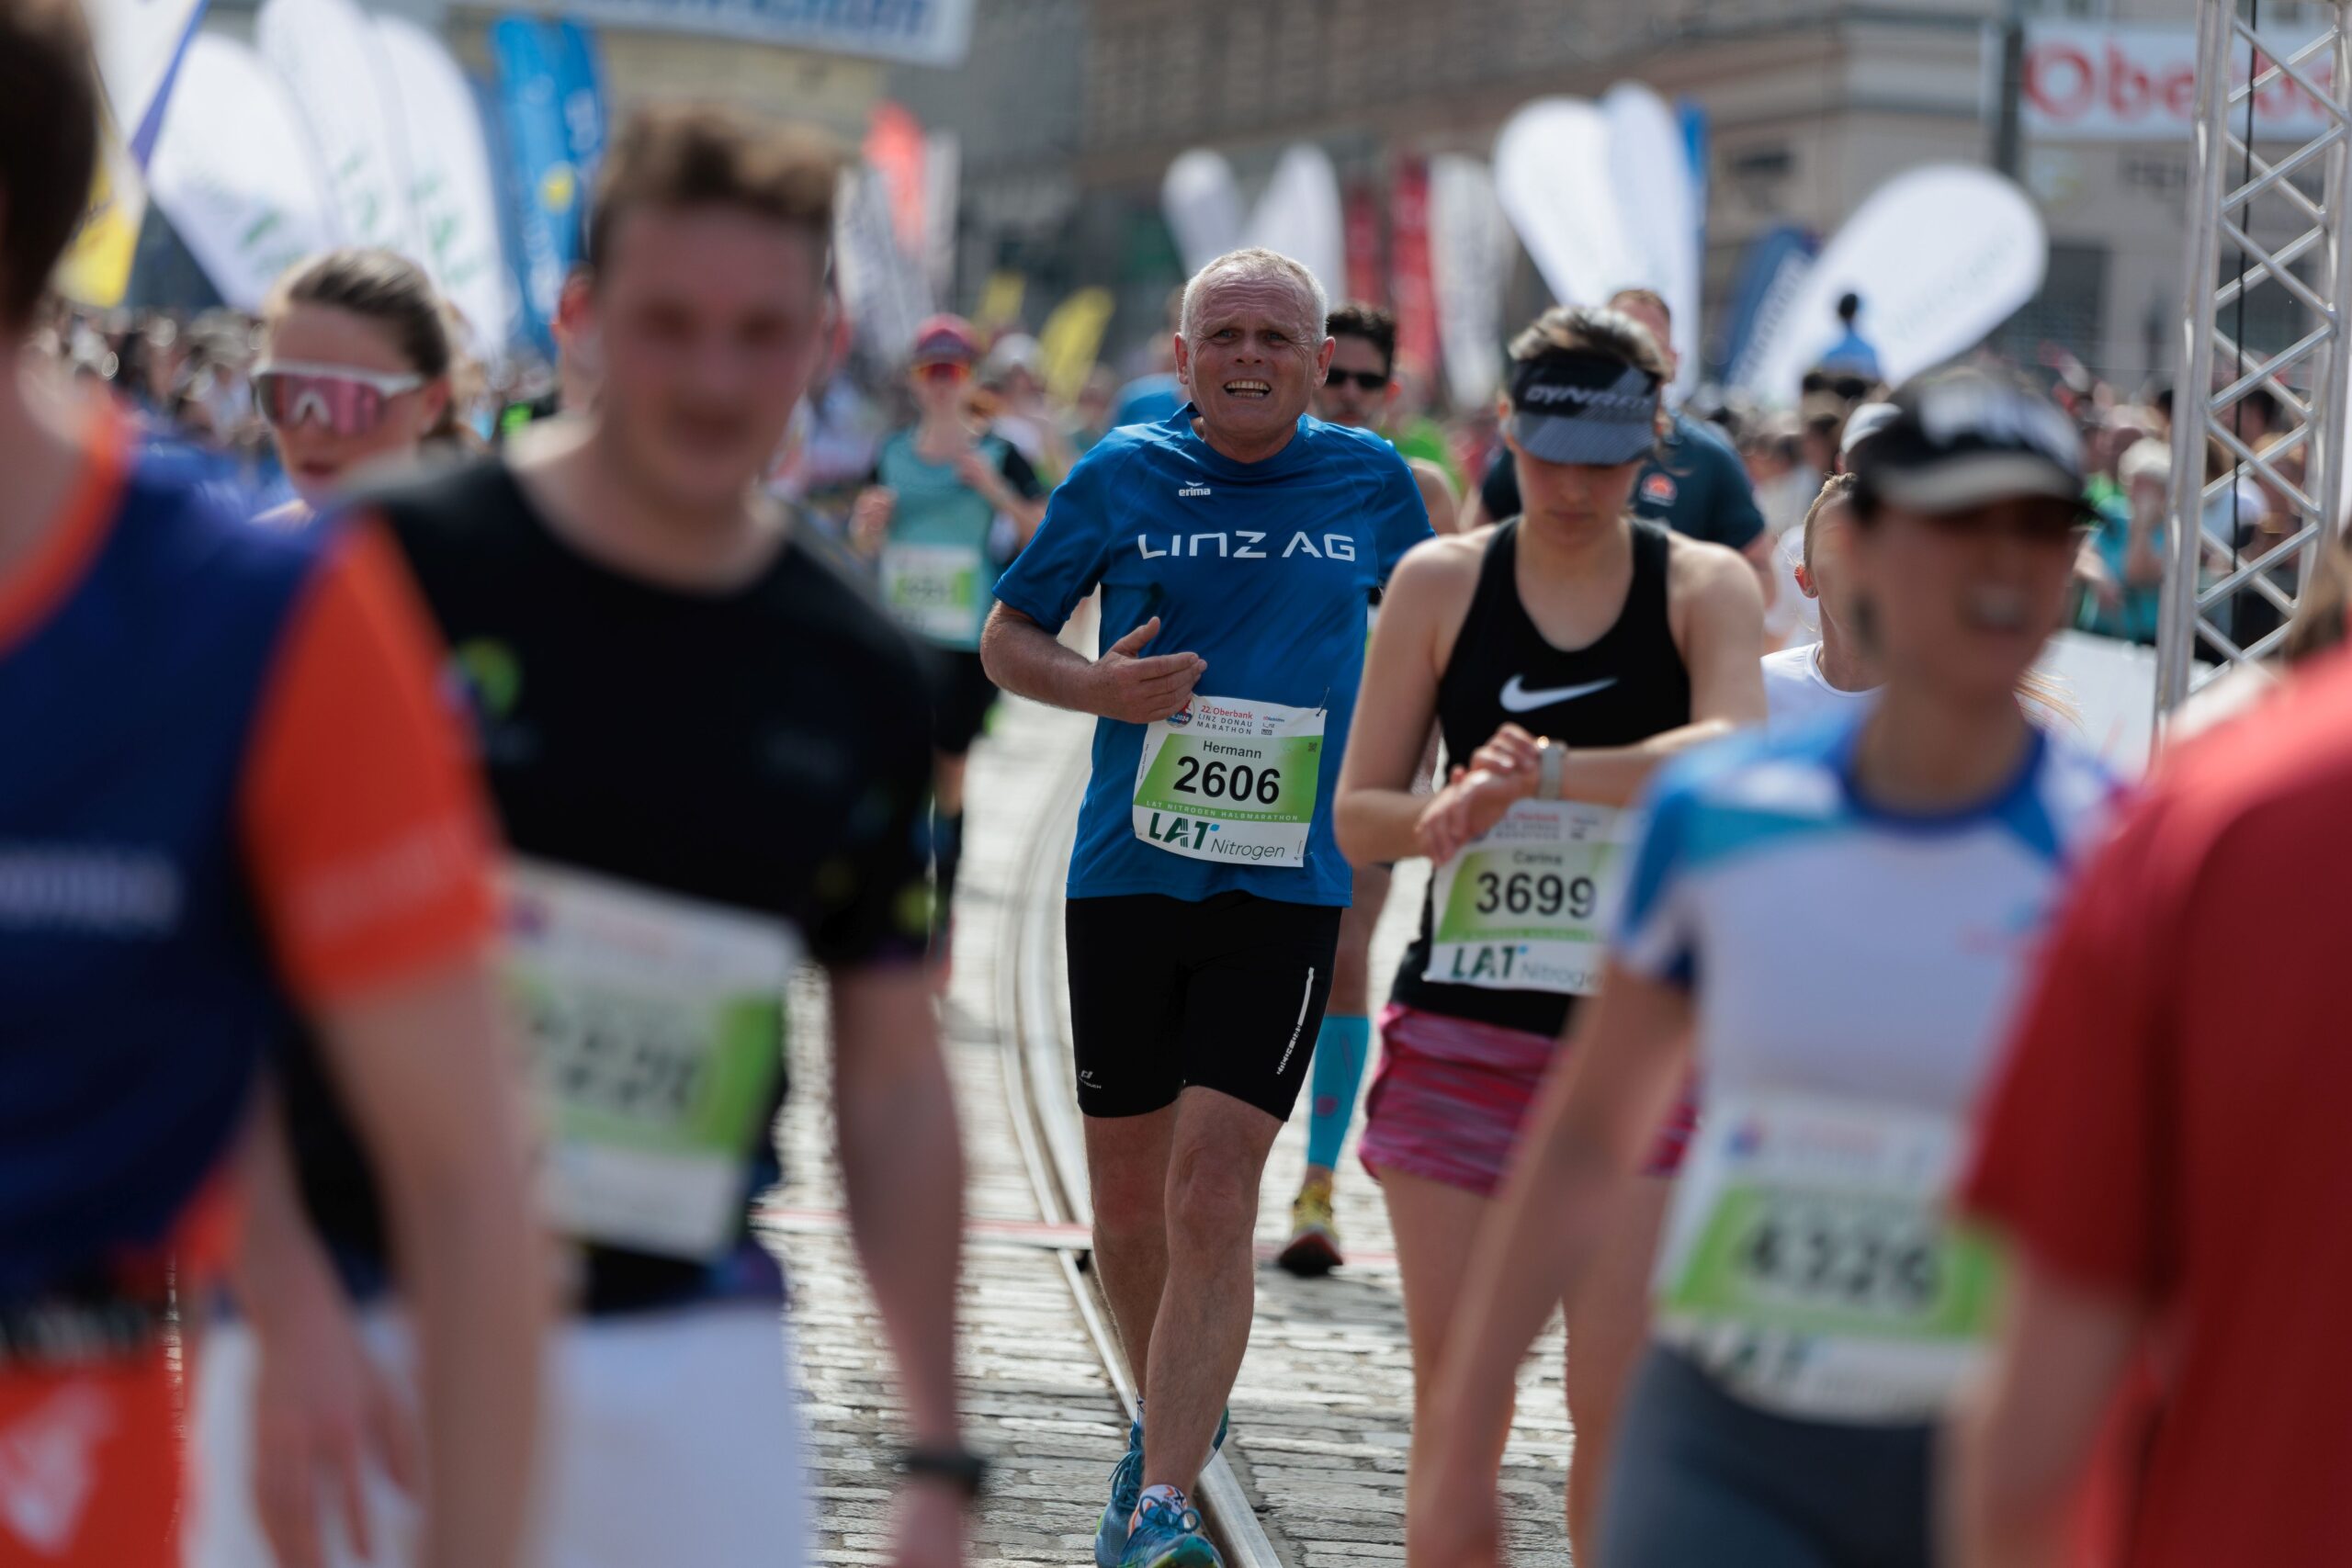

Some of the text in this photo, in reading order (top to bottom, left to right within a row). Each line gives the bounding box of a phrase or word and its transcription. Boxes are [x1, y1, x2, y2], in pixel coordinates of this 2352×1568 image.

[1178, 487, 1211, 497] erima
[1137, 530, 1356, 561] LINZ AG
[1198, 714, 1216, 723] LINZ
[1220, 717, 1253, 728] DONAU
[1213, 707, 1253, 720] Oberbank
[1196, 721, 1252, 735] MARATHON
[1203, 740, 1262, 760] Hermann
[1173, 755, 1282, 806] 2606
[1146, 800, 1298, 821] LAT NITROGEN HALBMARATHON
[1148, 812, 1285, 861] LAT Nitrogen
[1476, 871, 1598, 919] 3699
[1451, 945, 1518, 979] LAT
